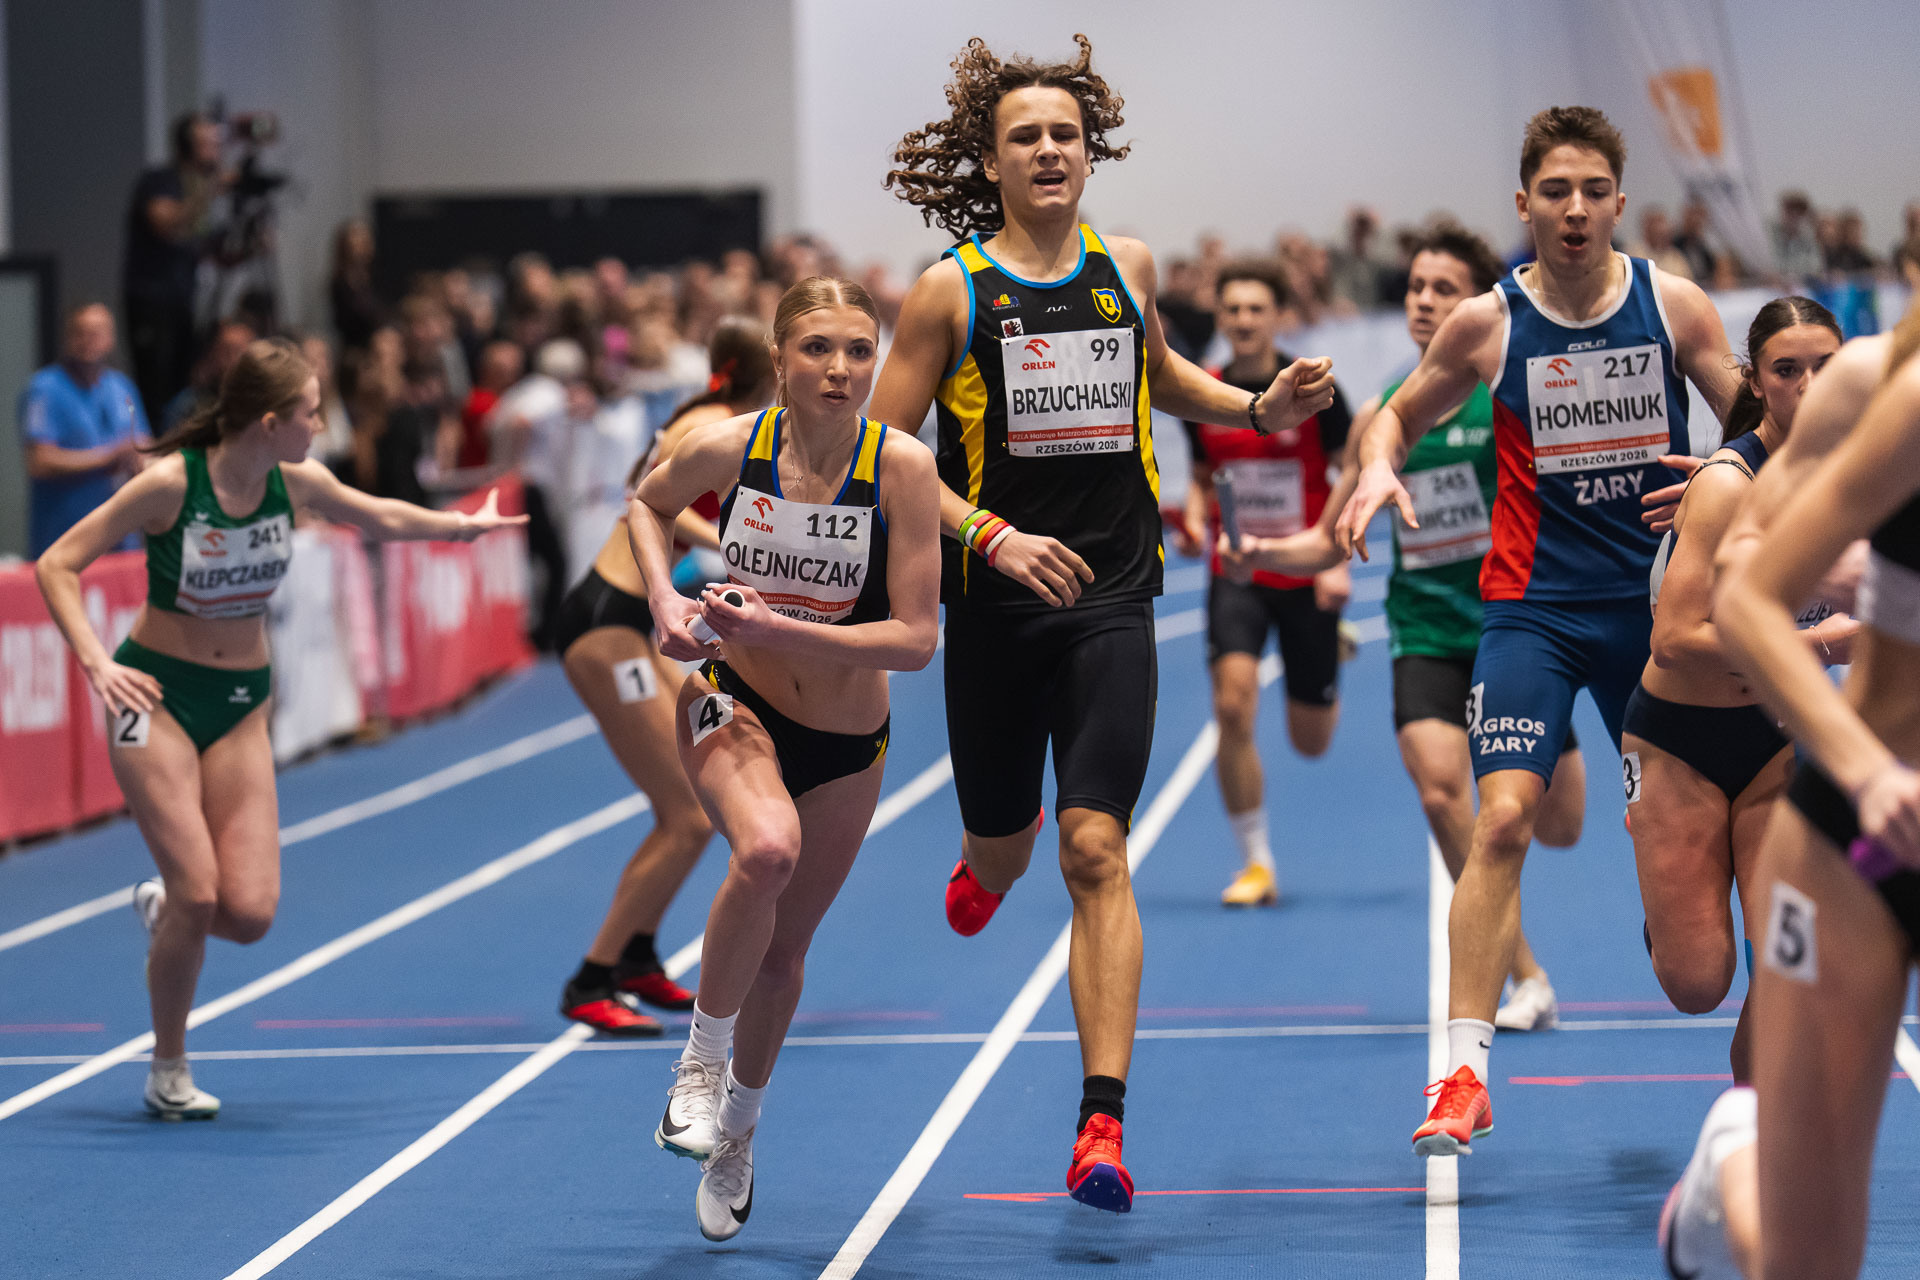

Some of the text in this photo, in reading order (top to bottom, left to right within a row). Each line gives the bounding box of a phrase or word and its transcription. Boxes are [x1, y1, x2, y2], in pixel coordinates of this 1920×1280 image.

[1090, 338, 1120, 361] 99
[1022, 361, 1056, 371] ORLEN
[1603, 352, 1651, 378] 217
[1544, 379, 1578, 389] ORLEN
[1012, 382, 1131, 416] BRZUCHALSKI
[1536, 392, 1664, 431] HOMENIUK
[1036, 440, 1119, 454] RZESZÓW 2026
[1561, 449, 1648, 468] RZESZÓW 2026
[1573, 469, 1644, 506] ŻARY
[249, 524, 281, 549] 241
[744, 517, 774, 534] ORLEN
[806, 513, 858, 540] 112
[725, 541, 862, 588] OLEJNICZAK
[803, 611, 832, 623] 2026
[806, 600, 825, 610] Polski
[626, 667, 645, 693] 1
[119, 708, 140, 742] 2
[699, 696, 723, 731] 4
[1480, 736, 1536, 756] ŻARY
[1623, 757, 1636, 800] 3
[1775, 902, 1805, 967] 5
